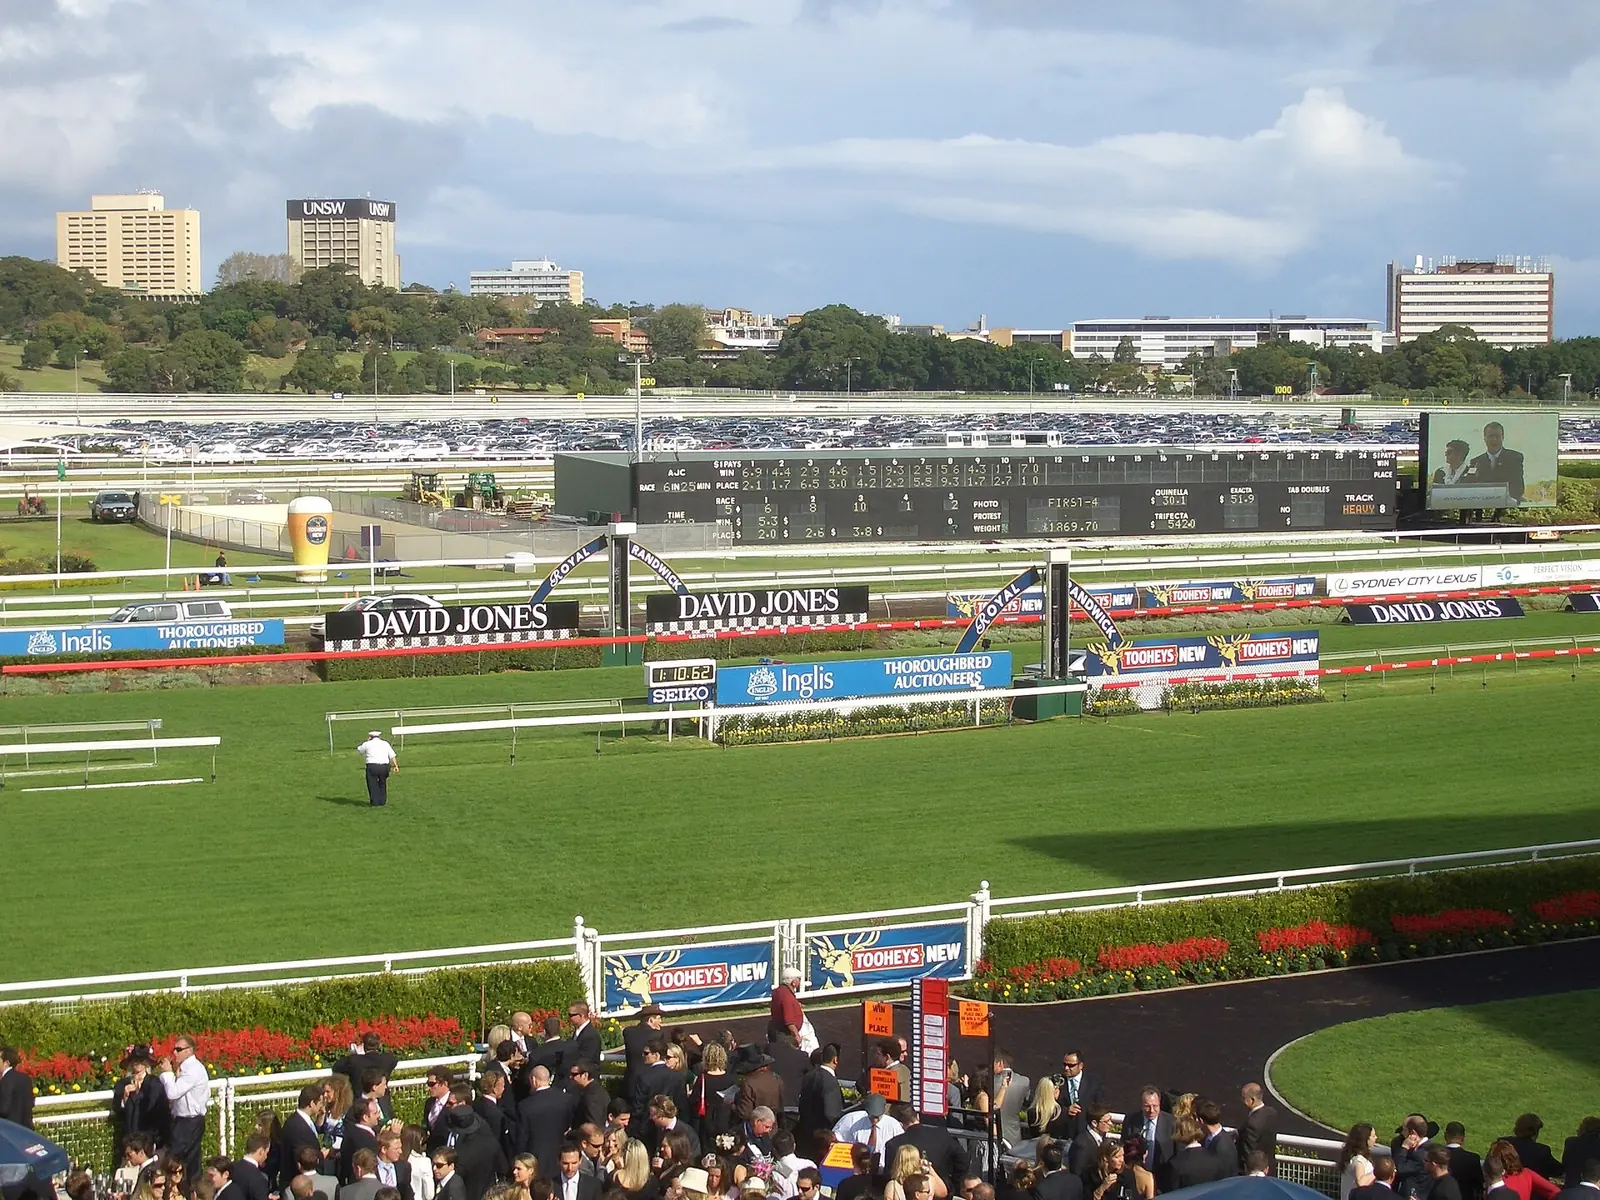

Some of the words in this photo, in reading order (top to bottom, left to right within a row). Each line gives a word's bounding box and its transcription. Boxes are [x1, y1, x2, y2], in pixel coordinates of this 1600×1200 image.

[303, 202, 345, 215] UNSW
[369, 203, 389, 216] UNSW
[1275, 386, 1292, 394] 1000
[663, 482, 671, 492] 6
[725, 505, 732, 514] 5
[765, 504, 771, 513] 6
[810, 503, 817, 512] 8
[853, 502, 867, 512] 10
[1343, 505, 1375, 514] HEAVY
[1380, 505, 1386, 513] 8
[736, 518, 741, 526] $
[784, 516, 788, 525] $
[736, 530, 741, 539] $
[784, 529, 788, 538] $
[831, 527, 836, 537] $
[973, 525, 1001, 533] WEIGHT
[550, 548, 590, 587] ROYAL
[631, 544, 682, 591] RANDWICK
[1560, 564, 1582, 572] VISION
[1351, 578, 1406, 589] SYDNEY
[1407, 576, 1435, 585] CITY
[1436, 574, 1477, 584] LEXUS
[1172, 589, 1209, 600] TOOHEYS
[1212, 588, 1232, 599] NEW
[1258, 585, 1293, 596] TOOHEYS
[1295, 584, 1314, 595] NEW
[679, 592, 756, 619] DAVID
[761, 589, 839, 615] JONES
[1022, 599, 1042, 611] NEW
[1113, 594, 1133, 606] NEW
[975, 583, 1020, 634] ROYAL
[1369, 602, 1435, 623] DAVID
[1440, 600, 1501, 620] JONES
[362, 608, 450, 638] DAVID
[456, 603, 548, 632] JONES
[62, 628, 112, 653] Inglis
[158, 622, 264, 638] THOROUGHBRED
[1242, 641, 1288, 657] TOOHEYS
[1293, 638, 1318, 655] NEW
[1124, 649, 1174, 666] TOOHEYS
[1179, 646, 1206, 662] NEW
[782, 665, 834, 698] Inglis
[884, 656, 992, 674] THOROUGHBRED
[894, 671, 982, 689] AUCTIONEERS
[653, 686, 709, 703] SEIKO
[856, 948, 920, 968] TOOHEYS
[926, 942, 962, 963] NEW
[653, 967, 725, 989] TOOHEYS
[730, 962, 769, 982] NEW
[873, 1005, 885, 1013] WIN
[869, 1024, 888, 1033] PLACE
